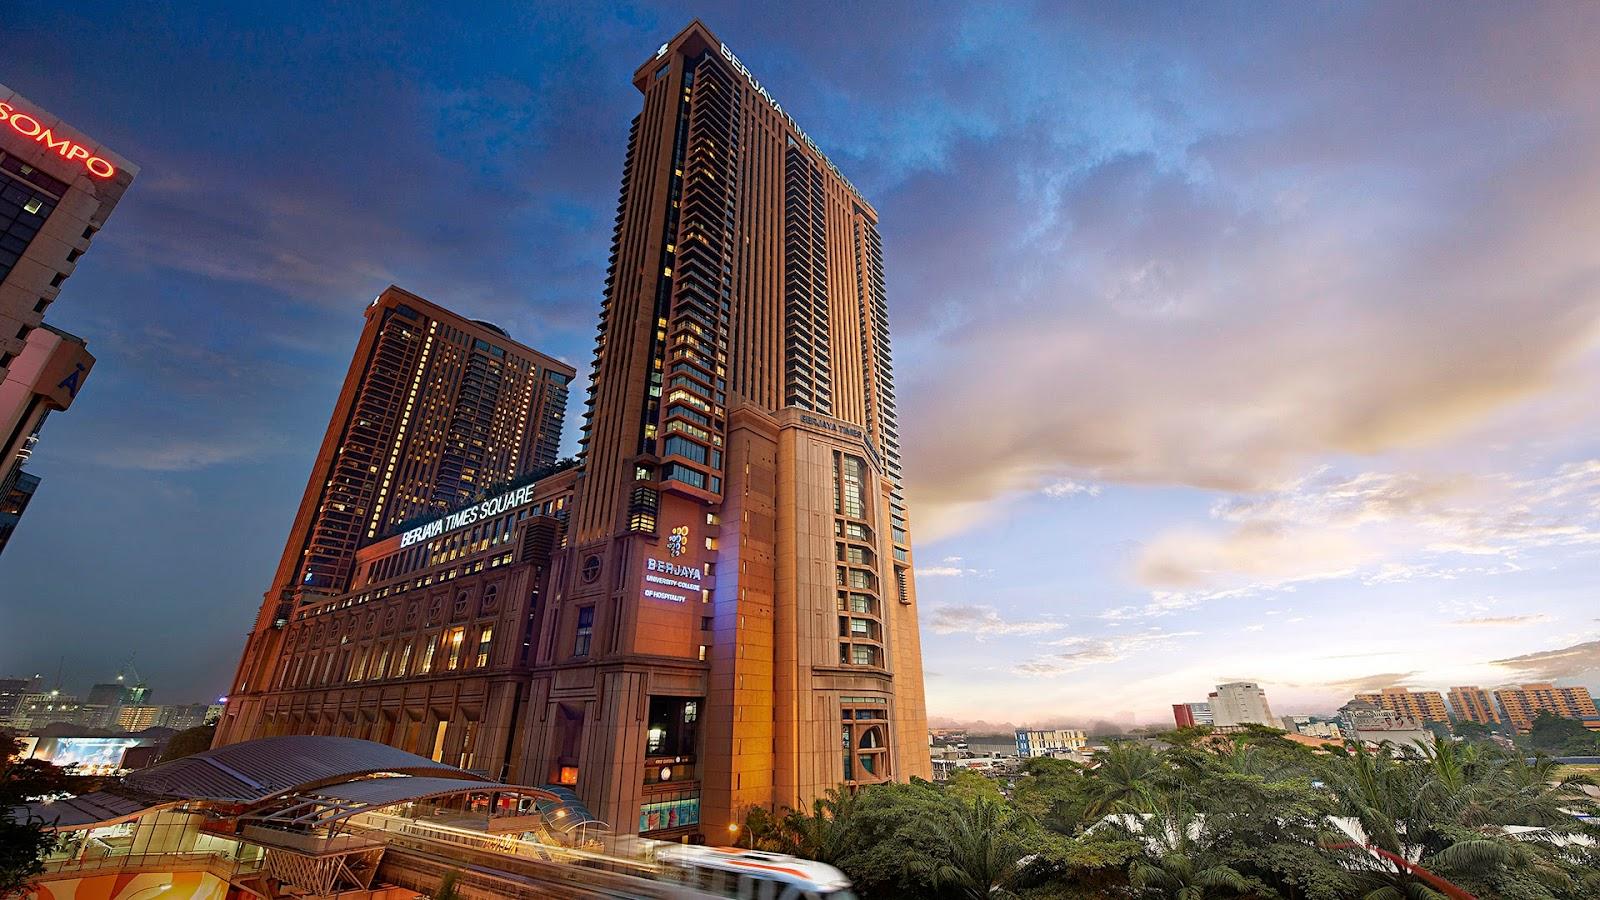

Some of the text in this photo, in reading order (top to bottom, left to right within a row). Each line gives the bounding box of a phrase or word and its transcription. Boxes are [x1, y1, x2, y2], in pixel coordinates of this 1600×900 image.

[720, 42, 784, 118] BERJAYA
[786, 111, 823, 160] TIMES
[0, 102, 114, 178] SOMPO
[400, 483, 536, 548] BERJAYA TIMES SQUARE
[644, 589, 685, 602] OF HOSPITALITY
[647, 558, 701, 580] BERJAYA
